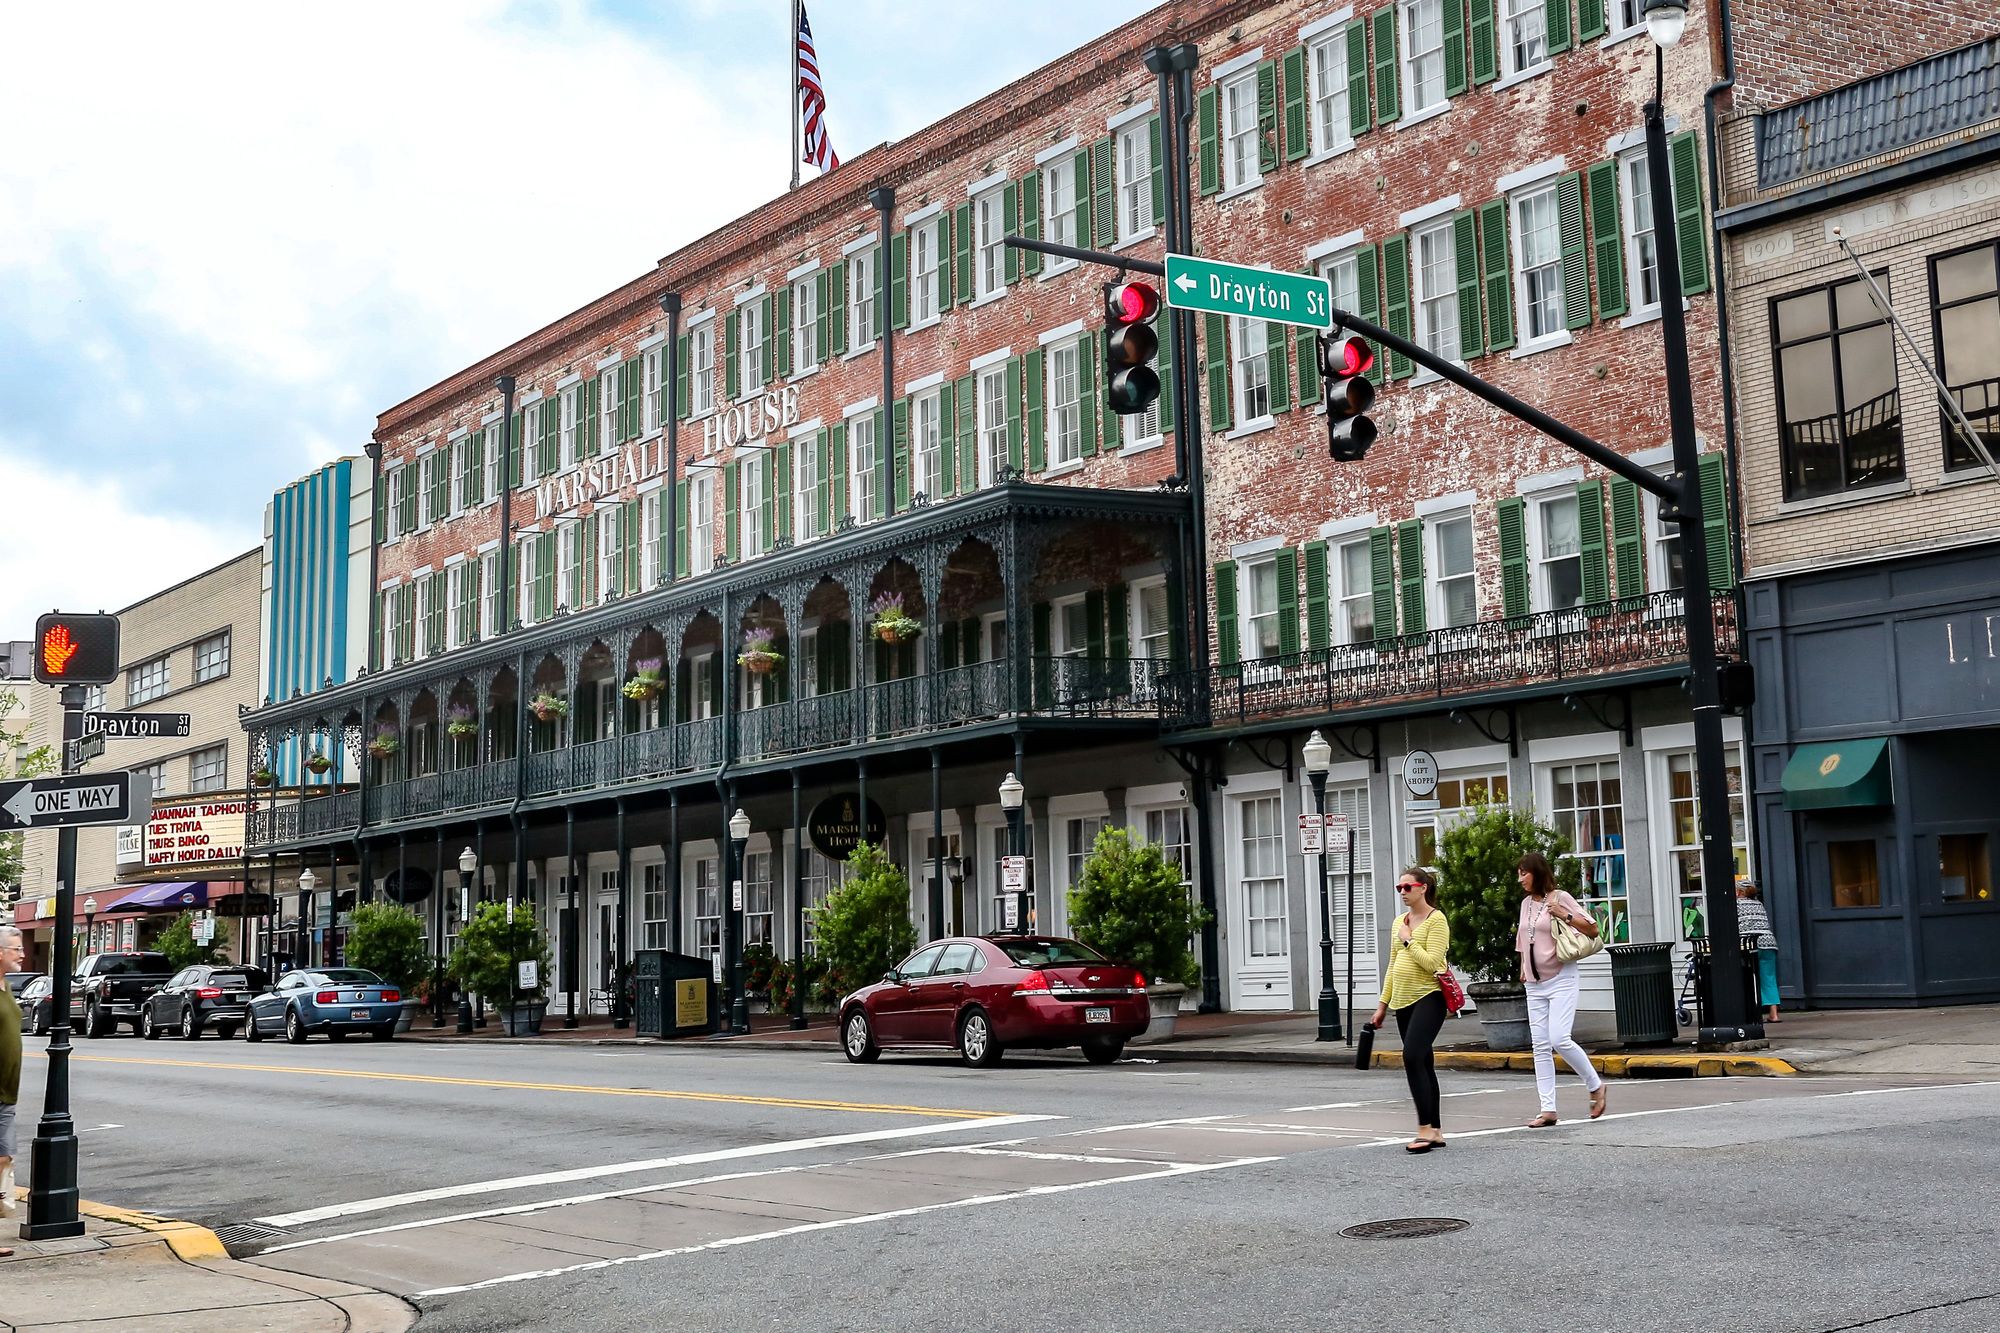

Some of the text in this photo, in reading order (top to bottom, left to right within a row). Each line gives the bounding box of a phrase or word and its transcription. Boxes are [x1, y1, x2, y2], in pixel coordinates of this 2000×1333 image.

[1862, 200, 1911, 227] LEVY
[1750, 237, 1788, 259] 1900
[1209, 273, 1326, 317] Drayton St
[534, 383, 800, 521] MARSHALL HOUSE
[88, 715, 189, 737] Drayton ST
[1408, 777, 1435, 785] SHOPPE
[35, 787, 115, 812] ONE WAY
[148, 821, 203, 835] TUES TRIVIA
[816, 823, 878, 834] MARSHLL
[148, 834, 210, 849] THURS BINGO
[829, 836, 859, 847] HOU
[178, 849, 205, 862] HOUR
[207, 846, 243, 859] DAILY
[281, 962, 287, 971] P
